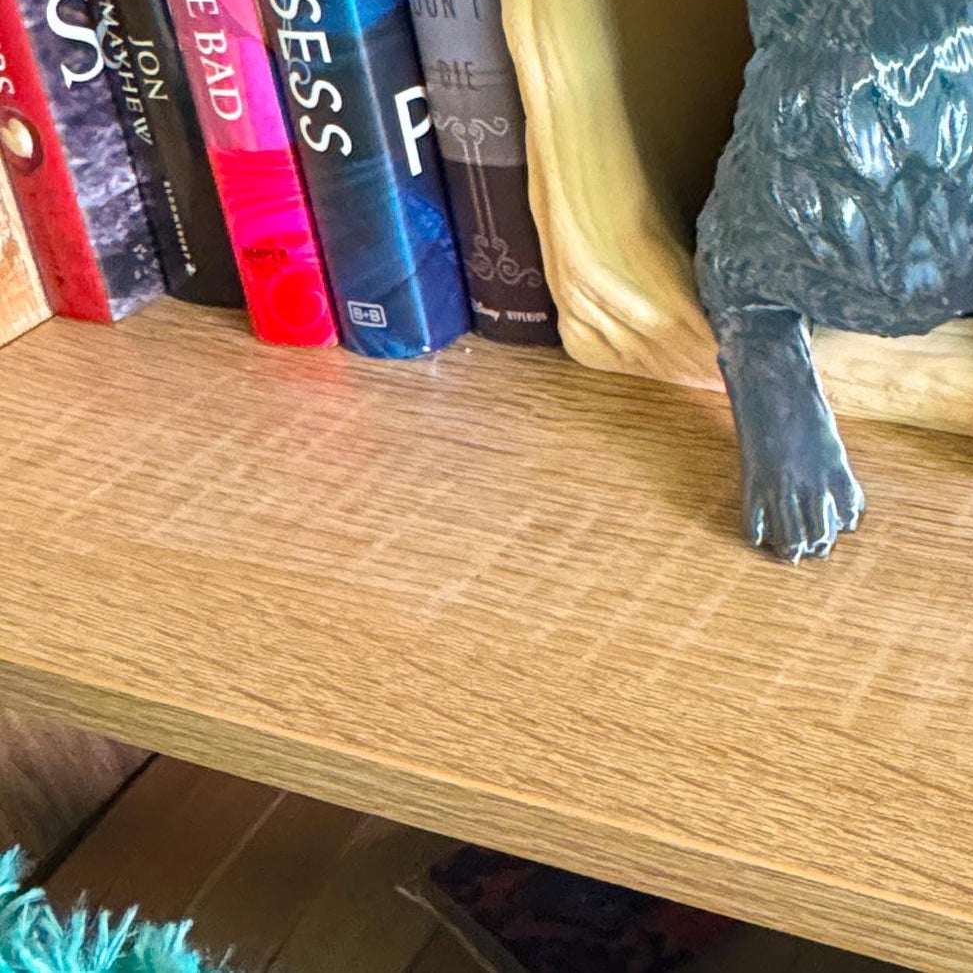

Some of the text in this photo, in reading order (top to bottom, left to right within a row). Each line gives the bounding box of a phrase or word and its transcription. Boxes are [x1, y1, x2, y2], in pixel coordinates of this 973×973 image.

[98, 1, 153, 145] MAYHEW
[128, 35, 168, 101] JON
[194, 29, 243, 122] BAD
